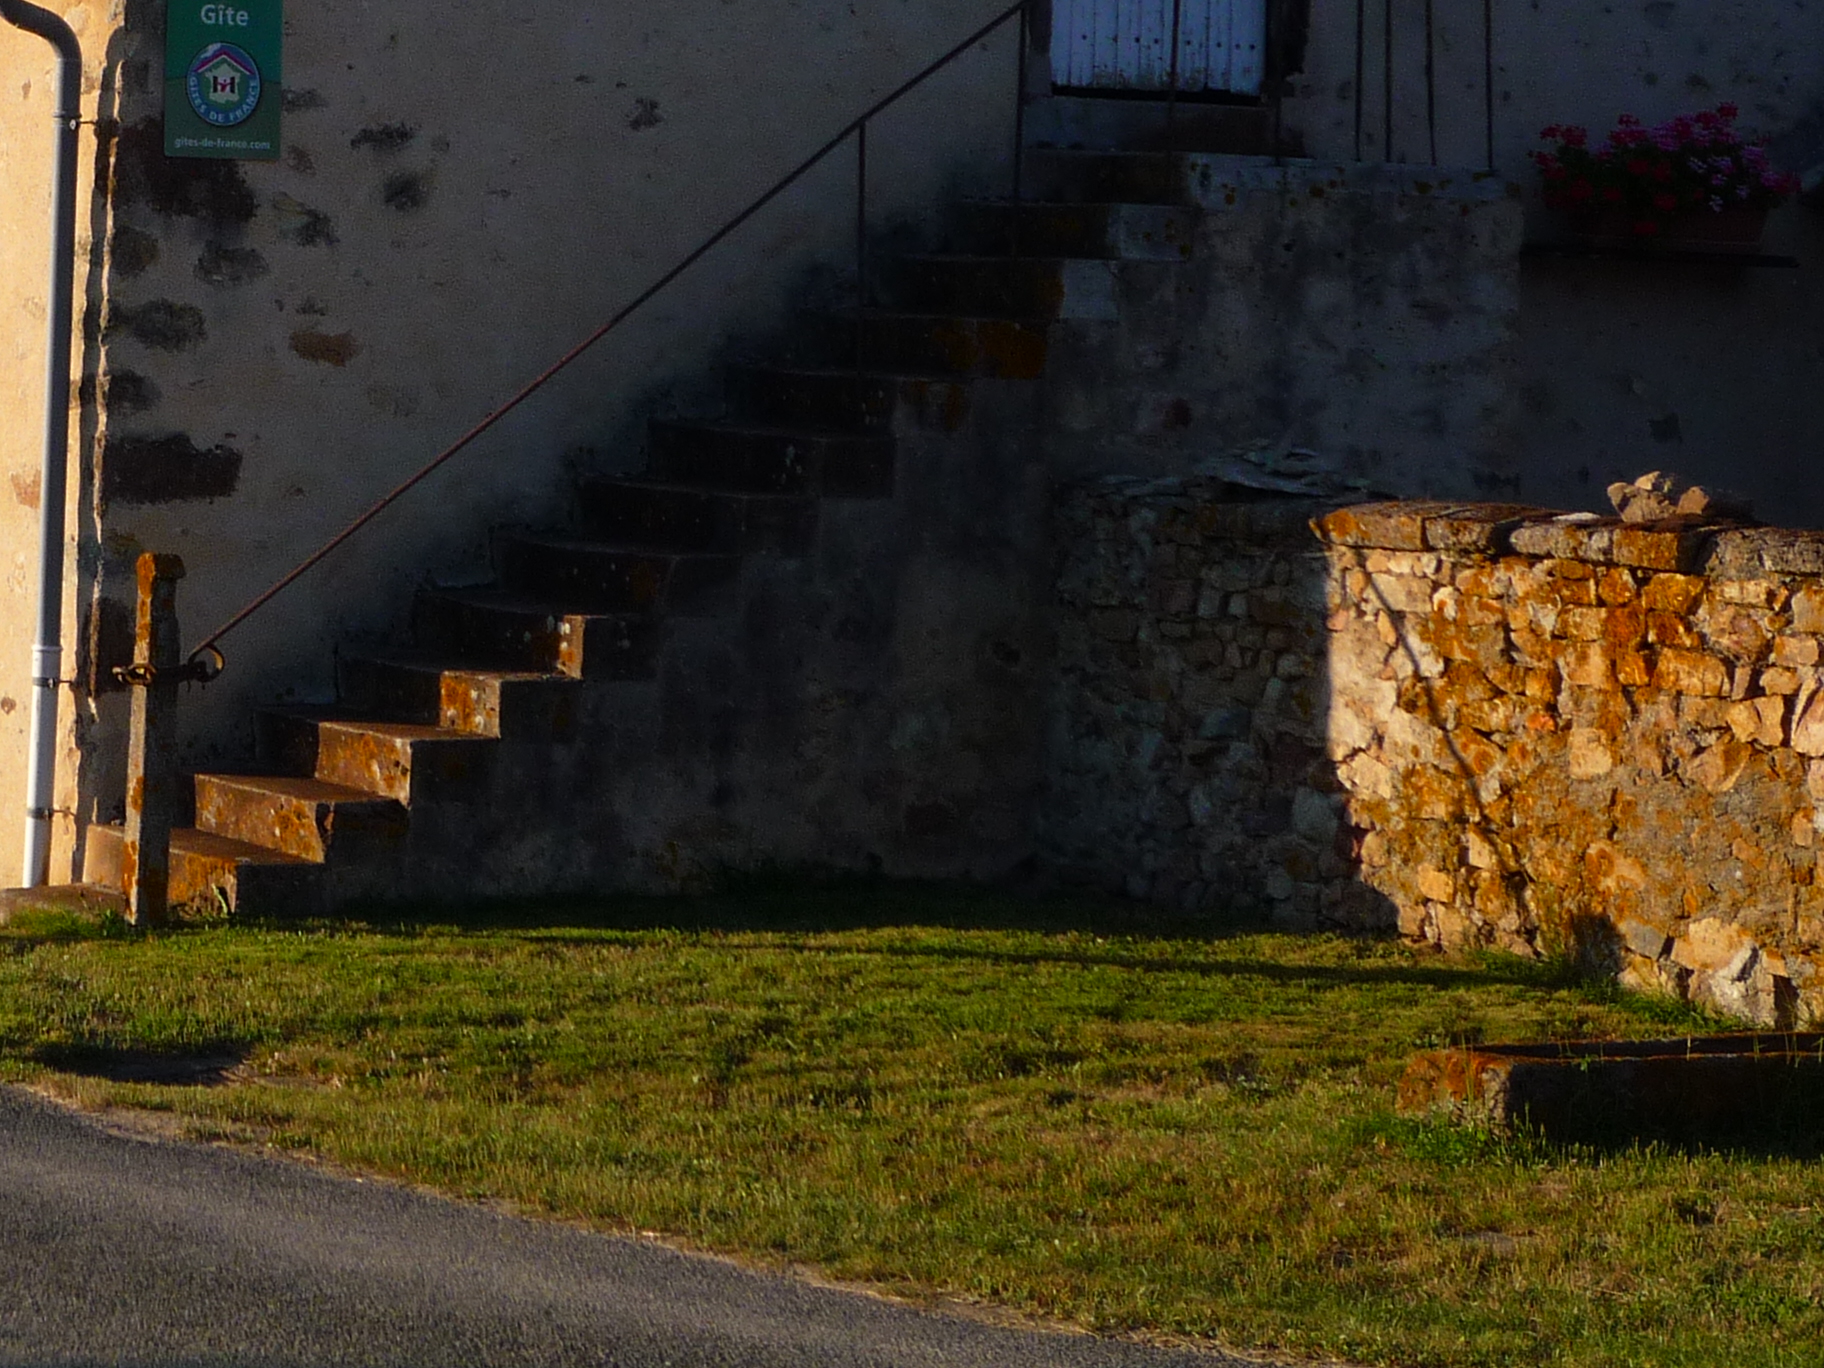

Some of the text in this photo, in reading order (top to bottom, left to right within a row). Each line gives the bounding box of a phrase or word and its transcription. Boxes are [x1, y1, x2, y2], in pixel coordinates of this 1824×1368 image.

[200, 4, 250, 26] Gîte
[209, 111, 225, 123] DE
[229, 78, 258, 122] FRANCE
[174, 136, 270, 150] gites-de-france.com
